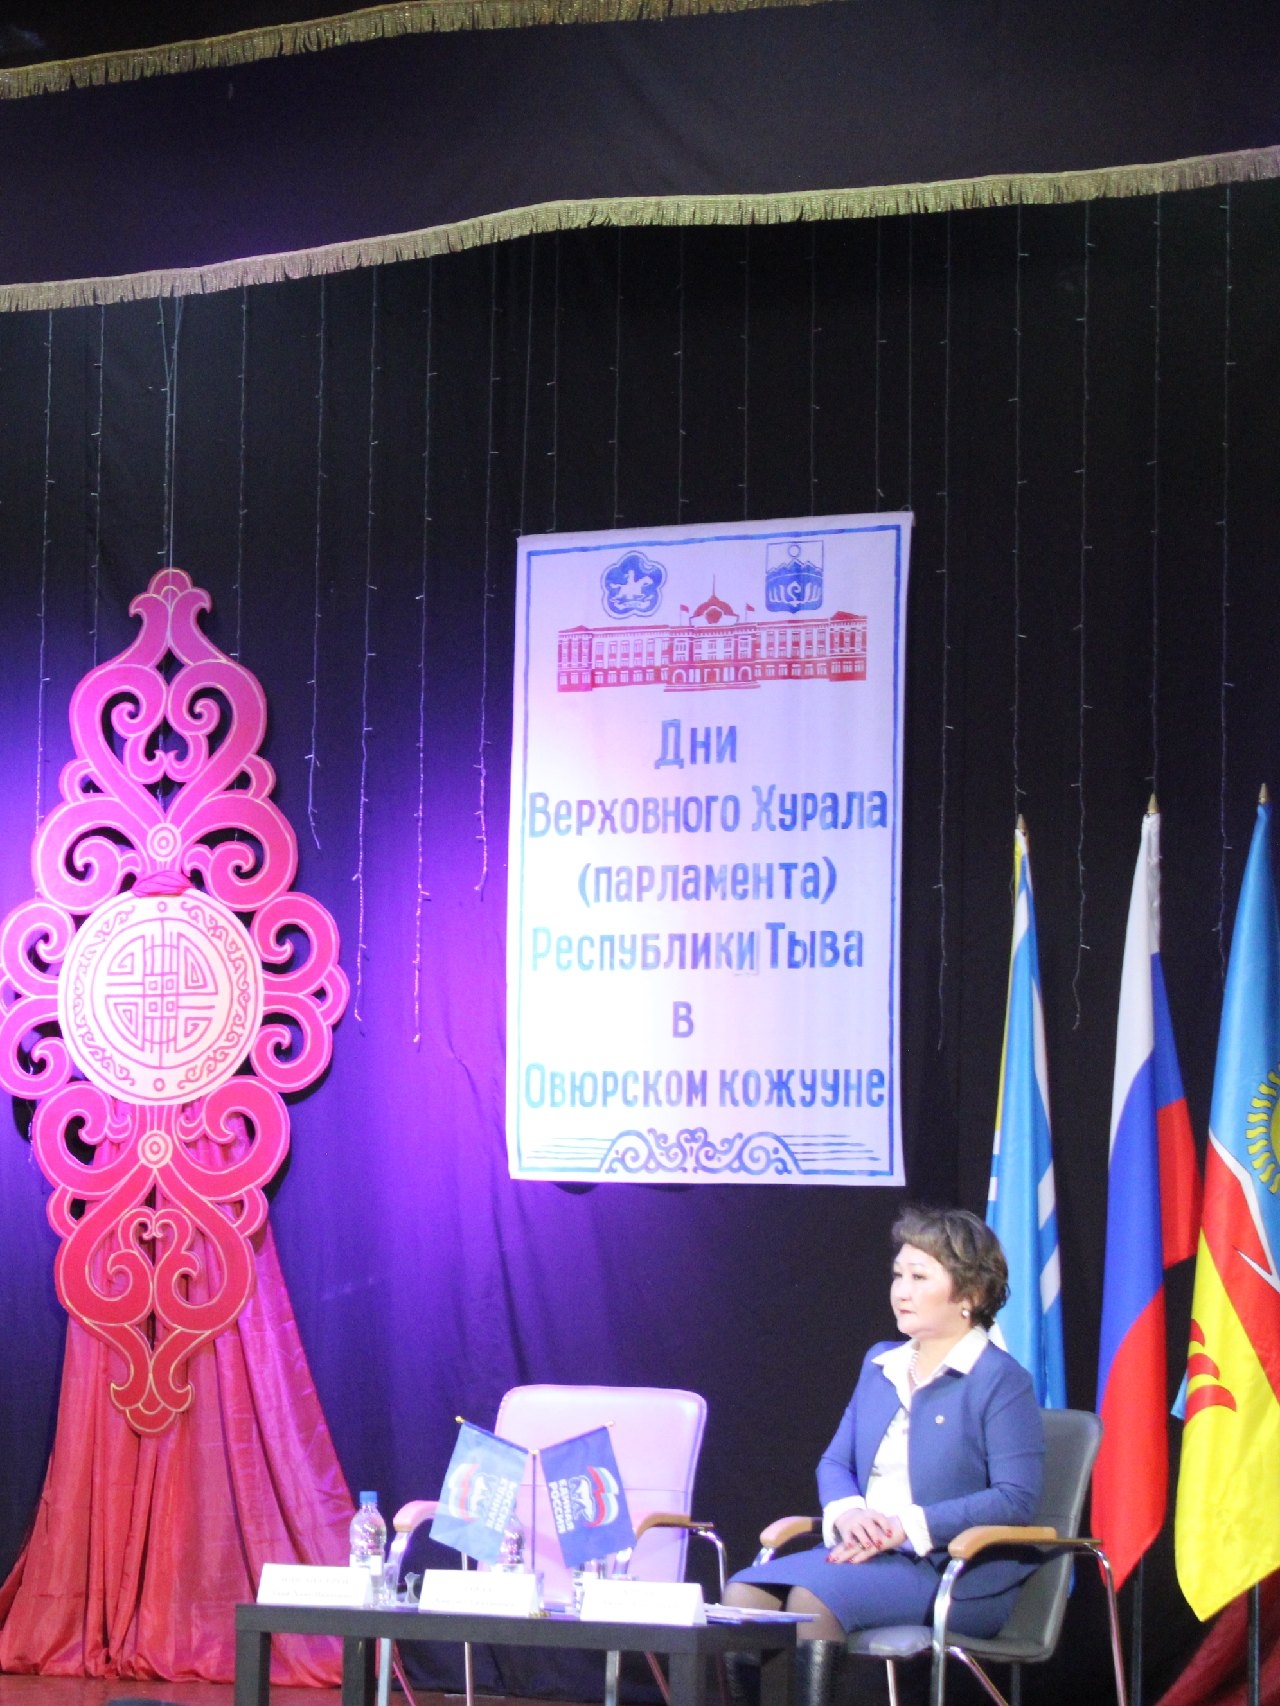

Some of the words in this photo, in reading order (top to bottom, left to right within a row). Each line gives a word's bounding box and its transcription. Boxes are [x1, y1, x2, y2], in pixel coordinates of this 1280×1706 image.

[654, 718, 738, 770] Дни
[528, 792, 740, 838] Верховного
[751, 784, 888, 832] Хурала
[577, 856, 838, 908] (парламента)
[531, 927, 756, 972] Республики
[765, 921, 864, 969] Тыва
[524, 1062, 708, 1109] Овюрском
[720, 1068, 886, 1108] кожууне
